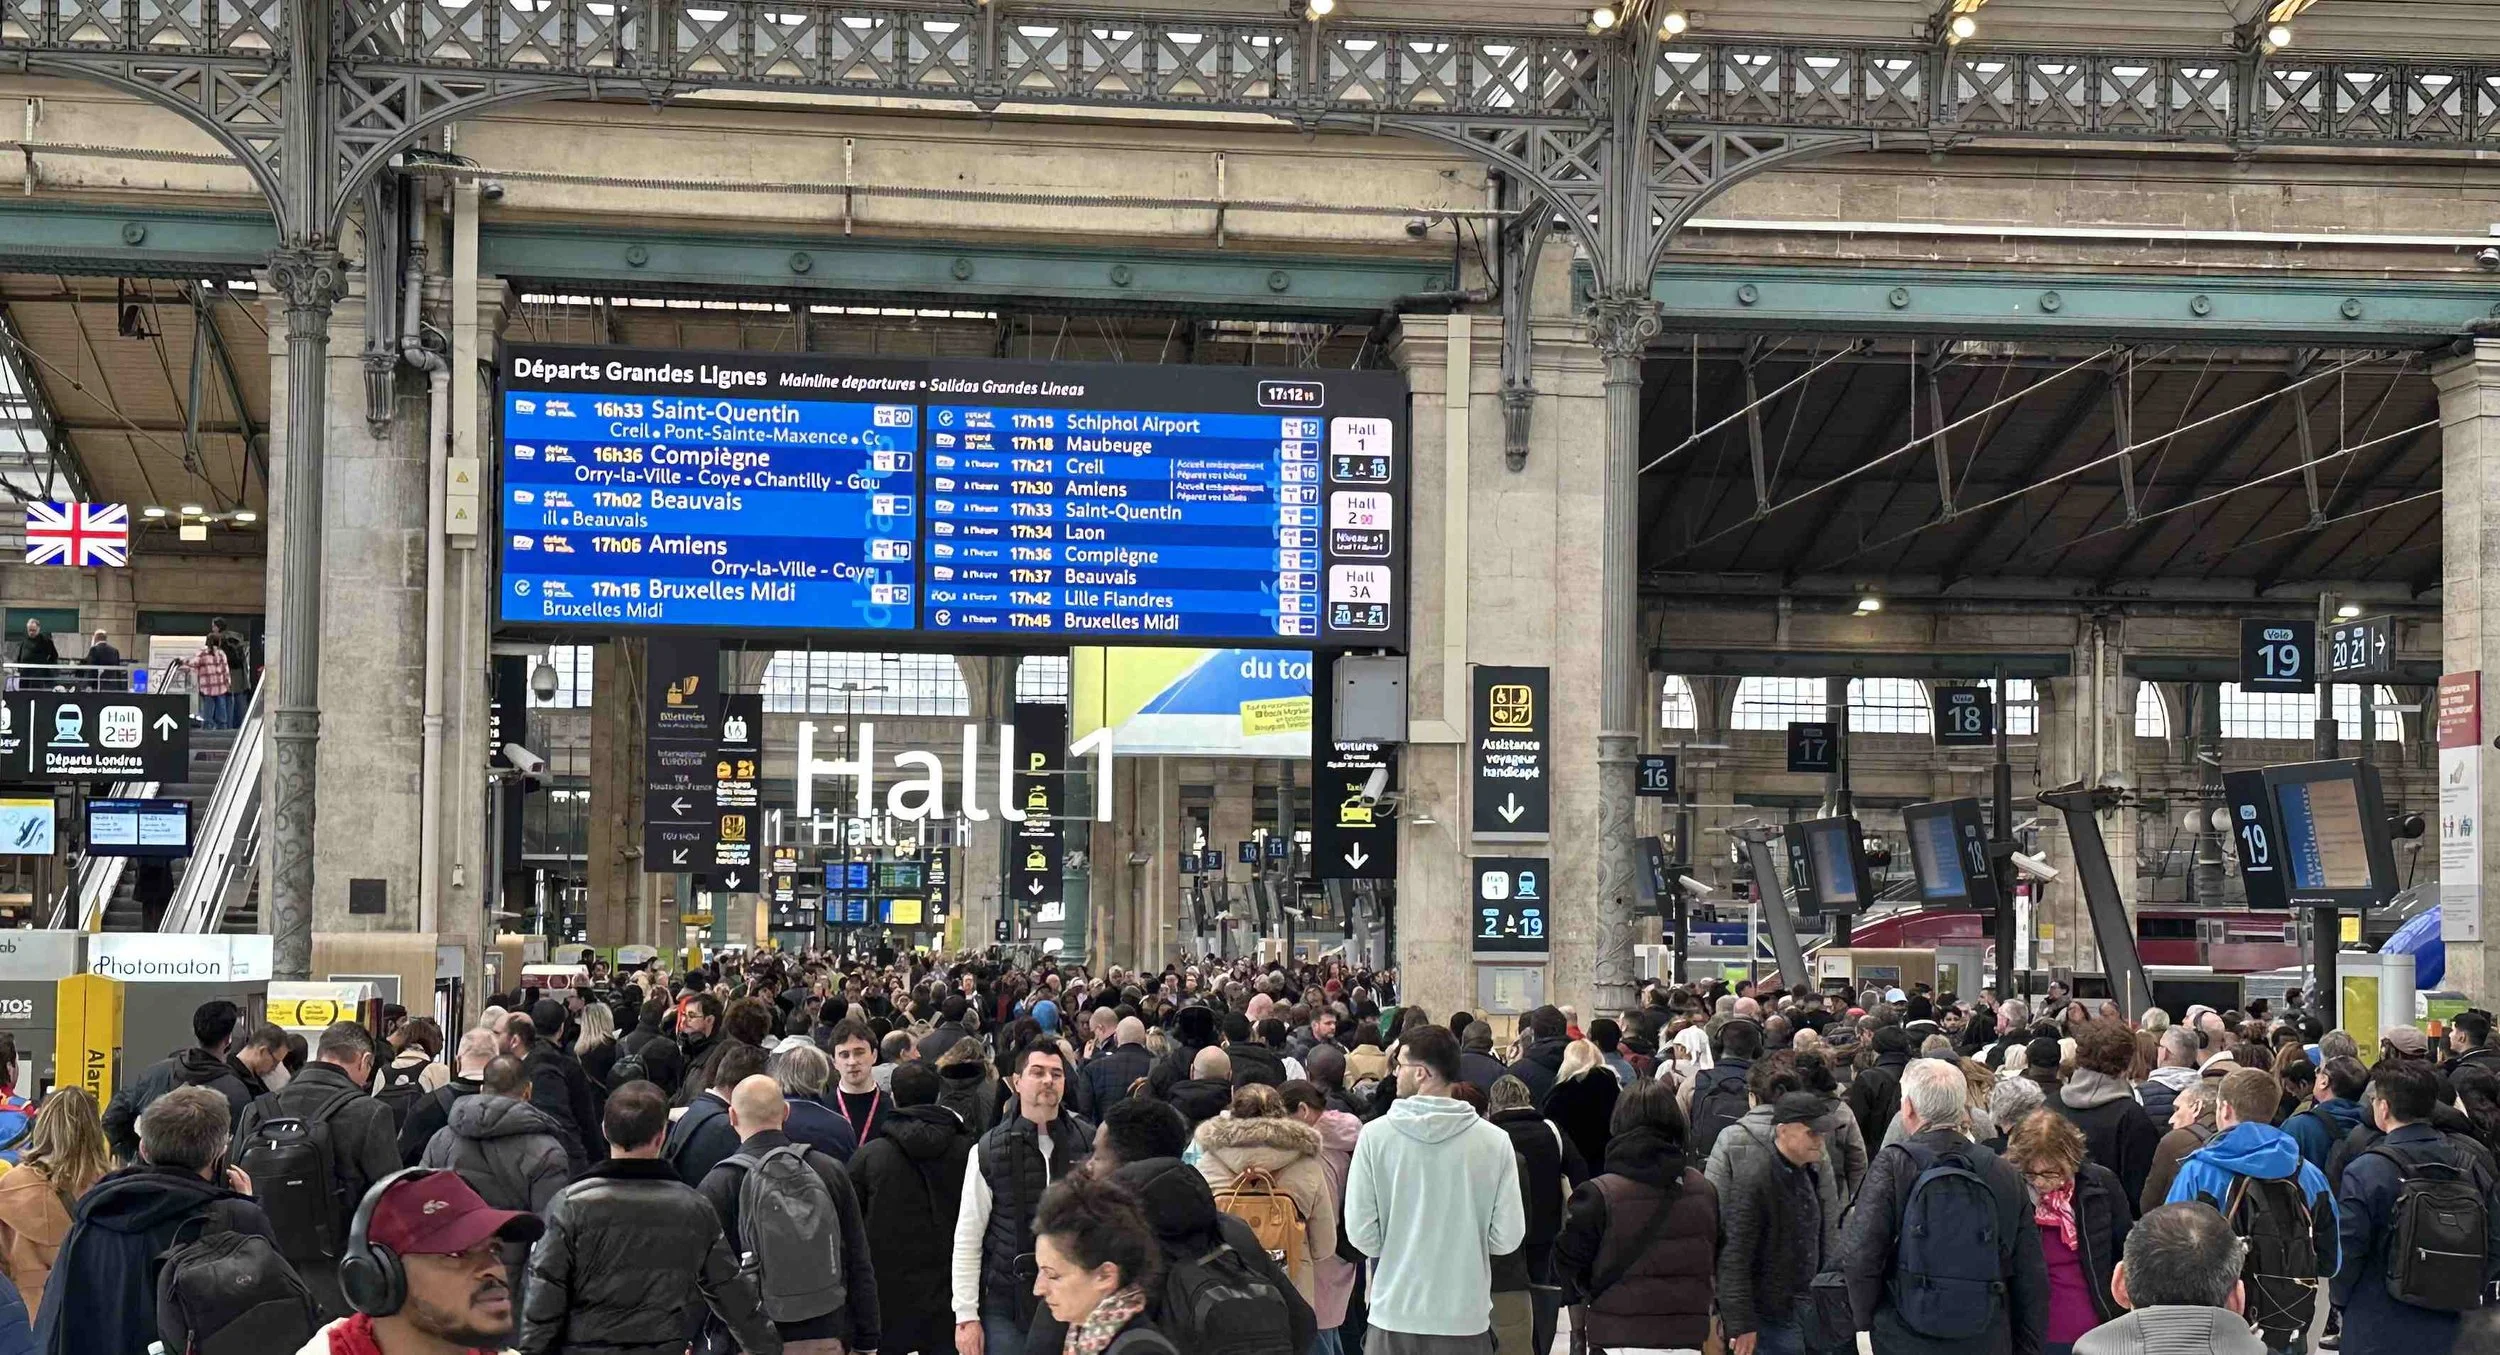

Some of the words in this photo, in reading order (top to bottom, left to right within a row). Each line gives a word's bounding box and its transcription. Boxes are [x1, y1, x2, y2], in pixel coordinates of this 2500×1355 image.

[514, 357, 600, 383] Départs
[605, 361, 694, 383] Grandes
[700, 363, 767, 389] Lignes
[779, 372, 839, 388] Mainline
[842, 375, 916, 392] departures
[929, 378, 979, 394] Salidas
[982, 379, 1038, 395] Grandes
[594, 401, 644, 418] 16h33
[652, 399, 800, 425] Saint-Quentin
[894, 411, 910, 424] 20
[610, 422, 650, 438] Creil
[664, 424, 848, 445] Pont-Sainte-Maxence
[1011, 414, 1054, 429] 17h15
[1067, 414, 1138, 433] Schiphol
[1142, 416, 1201, 436] Airport
[1302, 424, 1316, 435] 12
[1348, 423, 1376, 436] Hall
[1011, 436, 1054, 451] 17h18
[1066, 436, 1152, 456] Maubeuge
[1358, 439, 1365, 451] 1
[593, 446, 643, 463] 16h36
[651, 444, 771, 471] Compiègne
[897, 455, 906, 468] 7
[1011, 459, 1053, 473] 17h21
[1066, 458, 1105, 475] Creil
[575, 465, 681, 486] Orry-la-Ville
[698, 470, 741, 489] Coye
[755, 470, 831, 491] Chantilly
[1302, 467, 1316, 478] 16
[1340, 463, 1349, 475] 2
[1370, 464, 1387, 477] 19
[1011, 481, 1053, 495] 17h30
[1065, 480, 1127, 497] Amiens
[1301, 489, 1315, 501] 17
[593, 492, 642, 508] 17h02
[651, 489, 742, 512] Beauvais
[1348, 497, 1376, 510] Hall
[572, 510, 648, 528] Beauvais
[1011, 503, 1053, 517] 17h33
[1065, 502, 1182, 522] Saint-Quentin
[1348, 512, 1358, 524] 2
[1010, 525, 1053, 539] 17h34
[1065, 523, 1106, 541] Laon
[591, 536, 641, 553] 17h06
[648, 534, 728, 555] Amiens
[1010, 547, 1052, 561] 17h36
[1065, 546, 1159, 567] Compiègne
[711, 558, 816, 579] Orry-la-Ville
[833, 562, 875, 583] Coye
[1009, 569, 1052, 583] 17h37
[1065, 568, 1137, 585] Beauvais
[1346, 571, 1374, 583] Hall
[650, 578, 745, 600] Bruxelles
[751, 581, 796, 602] Midi
[893, 588, 908, 601] 12
[1009, 591, 1052, 605] 17h42
[1065, 590, 1098, 607] Lille
[1103, 591, 1174, 608] Flandres
[1349, 585, 1371, 598] 3A
[543, 600, 621, 618] Bruxelles
[626, 601, 663, 618] Midi
[1335, 610, 1351, 623] 20
[1368, 611, 1384, 624] 21
[1008, 613, 1052, 627] 17h45
[1064, 612, 1139, 630] Bruxelles
[1144, 614, 1179, 630] Midi
[2333, 641, 2348, 667] 20
[2351, 638, 2365, 664] 21
[1241, 656, 1273, 679] du
[2257, 644, 2301, 677] 19
[108, 711, 135, 722] Hall
[1948, 706, 1981, 732] 18
[105, 726, 116, 742] 2
[1482, 738, 1541, 751] Assistance
[1799, 739, 1828, 761] 17
[46, 752, 92, 768] Départs
[95, 754, 143, 766] Londres
[1030, 752, 1046, 772] P
[1485, 754, 1537, 767] voyageur
[796, 720, 1028, 823] Hall
[1069, 726, 1113, 822] 1
[1482, 765, 1541, 781] handicapé
[1643, 767, 1668, 787] 16
[813, 807, 897, 847] Hall
[2241, 824, 2268, 865] 19
[1967, 840, 1986, 874] 18
[1794, 858, 1808, 887] 17
[1492, 885, 1498, 896] 1
[1485, 917, 1497, 936] 2
[1519, 917, 1543, 936] 19
[0, 999, 33, 1013] TOS
